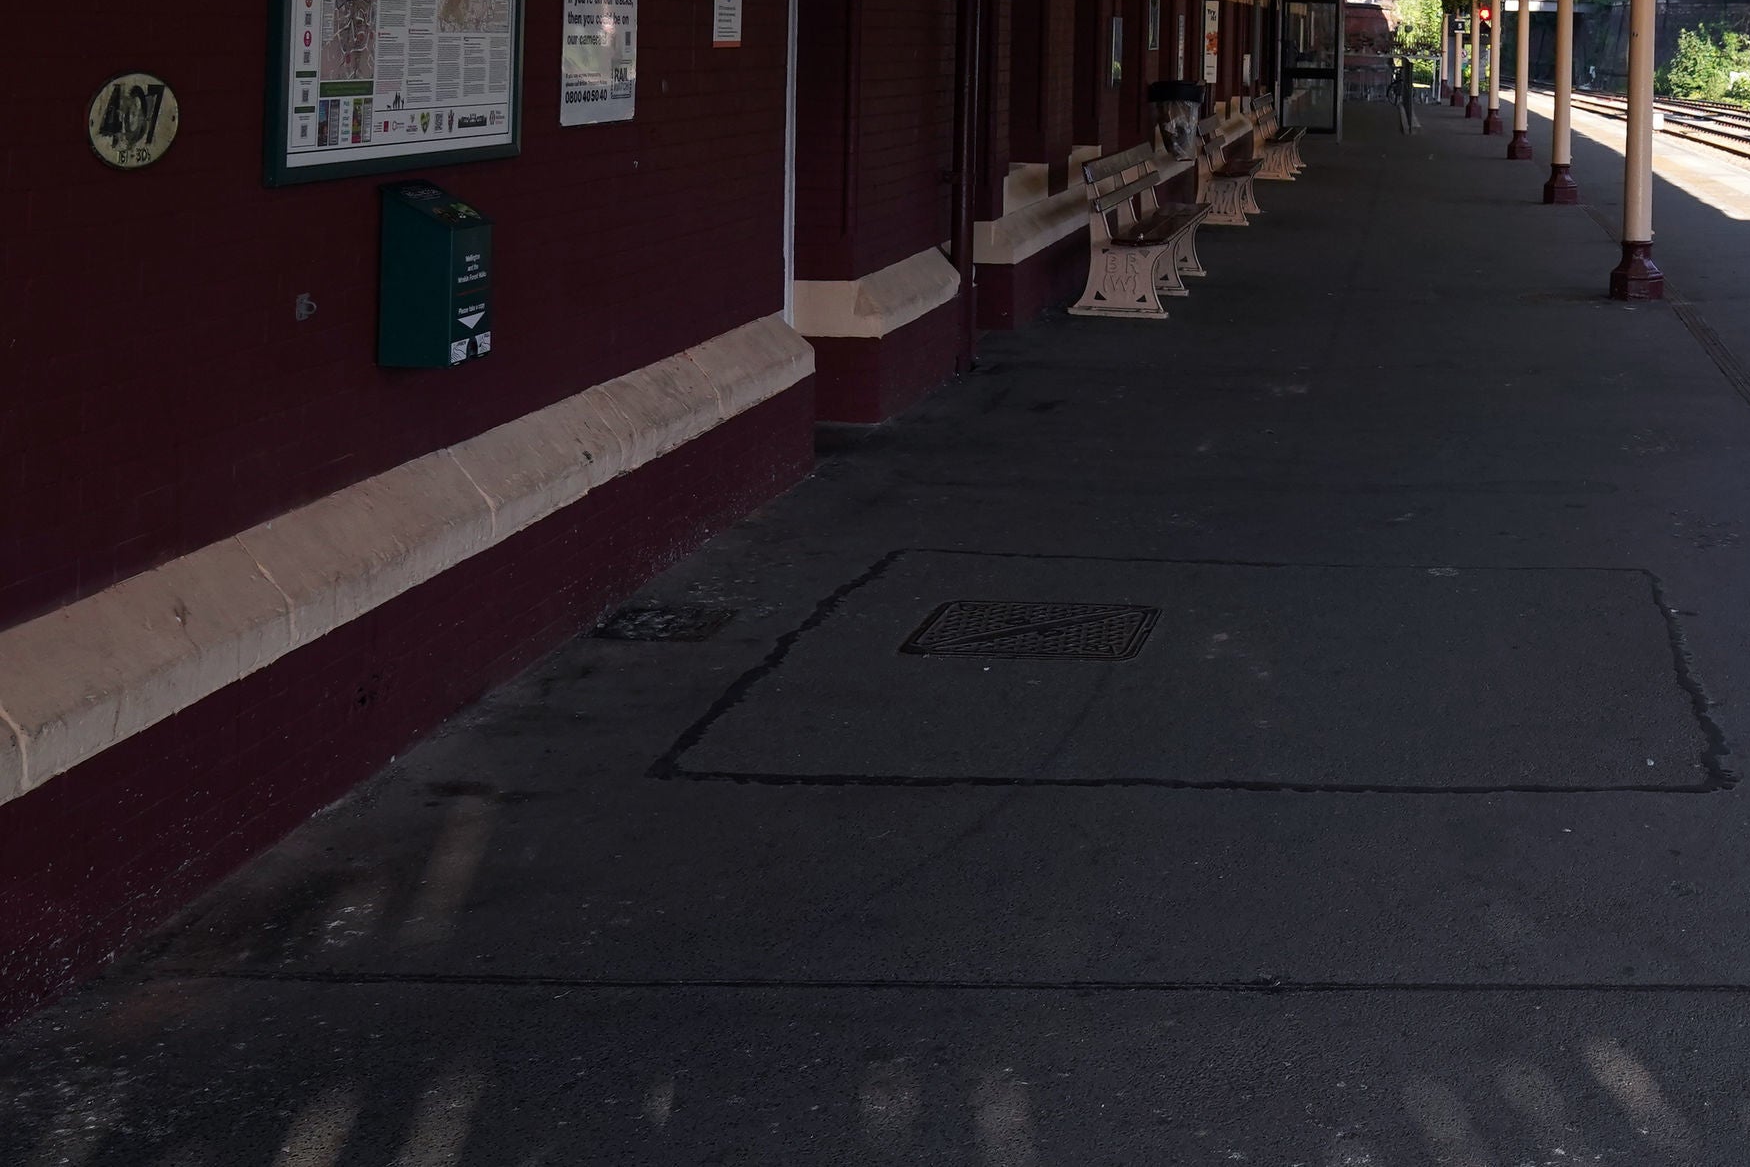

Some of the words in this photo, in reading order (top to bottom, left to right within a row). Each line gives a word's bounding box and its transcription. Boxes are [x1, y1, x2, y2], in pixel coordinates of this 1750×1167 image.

[568, 11, 582, 25] then
[583, 14, 595, 27] you
[621, 15, 630, 25] on
[1207, 8, 1216, 16] Try
[567, 35, 579, 45] our
[565, 90, 582, 104] 0800
[582, 90, 590, 102] 40
[591, 89, 599, 102] 50
[600, 89, 608, 101] 40
[99, 84, 165, 148] 407
